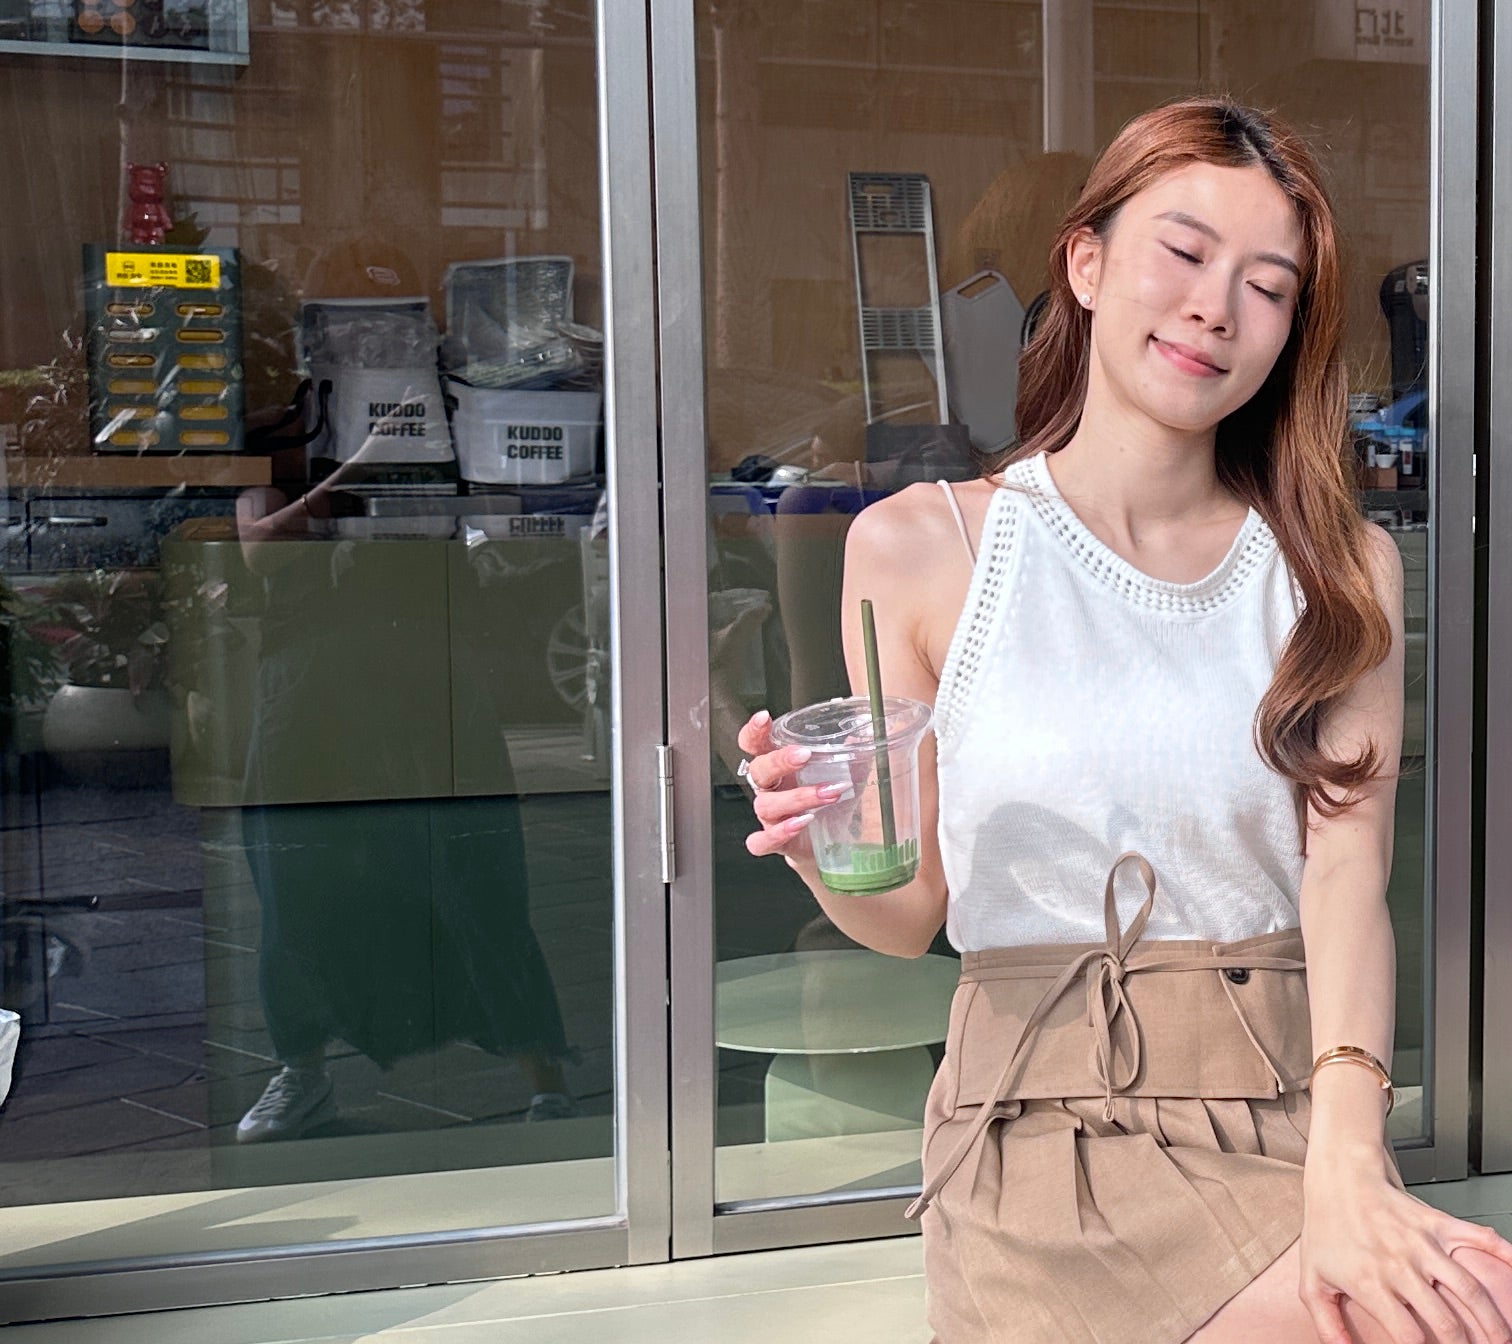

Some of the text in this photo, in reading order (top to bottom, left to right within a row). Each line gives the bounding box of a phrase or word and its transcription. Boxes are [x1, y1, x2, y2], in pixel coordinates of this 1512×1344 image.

[368, 402, 426, 418] KUDDO
[368, 422, 427, 437] COFFEE
[507, 425, 563, 441] KUDDO
[507, 445, 564, 460] COFFEE
